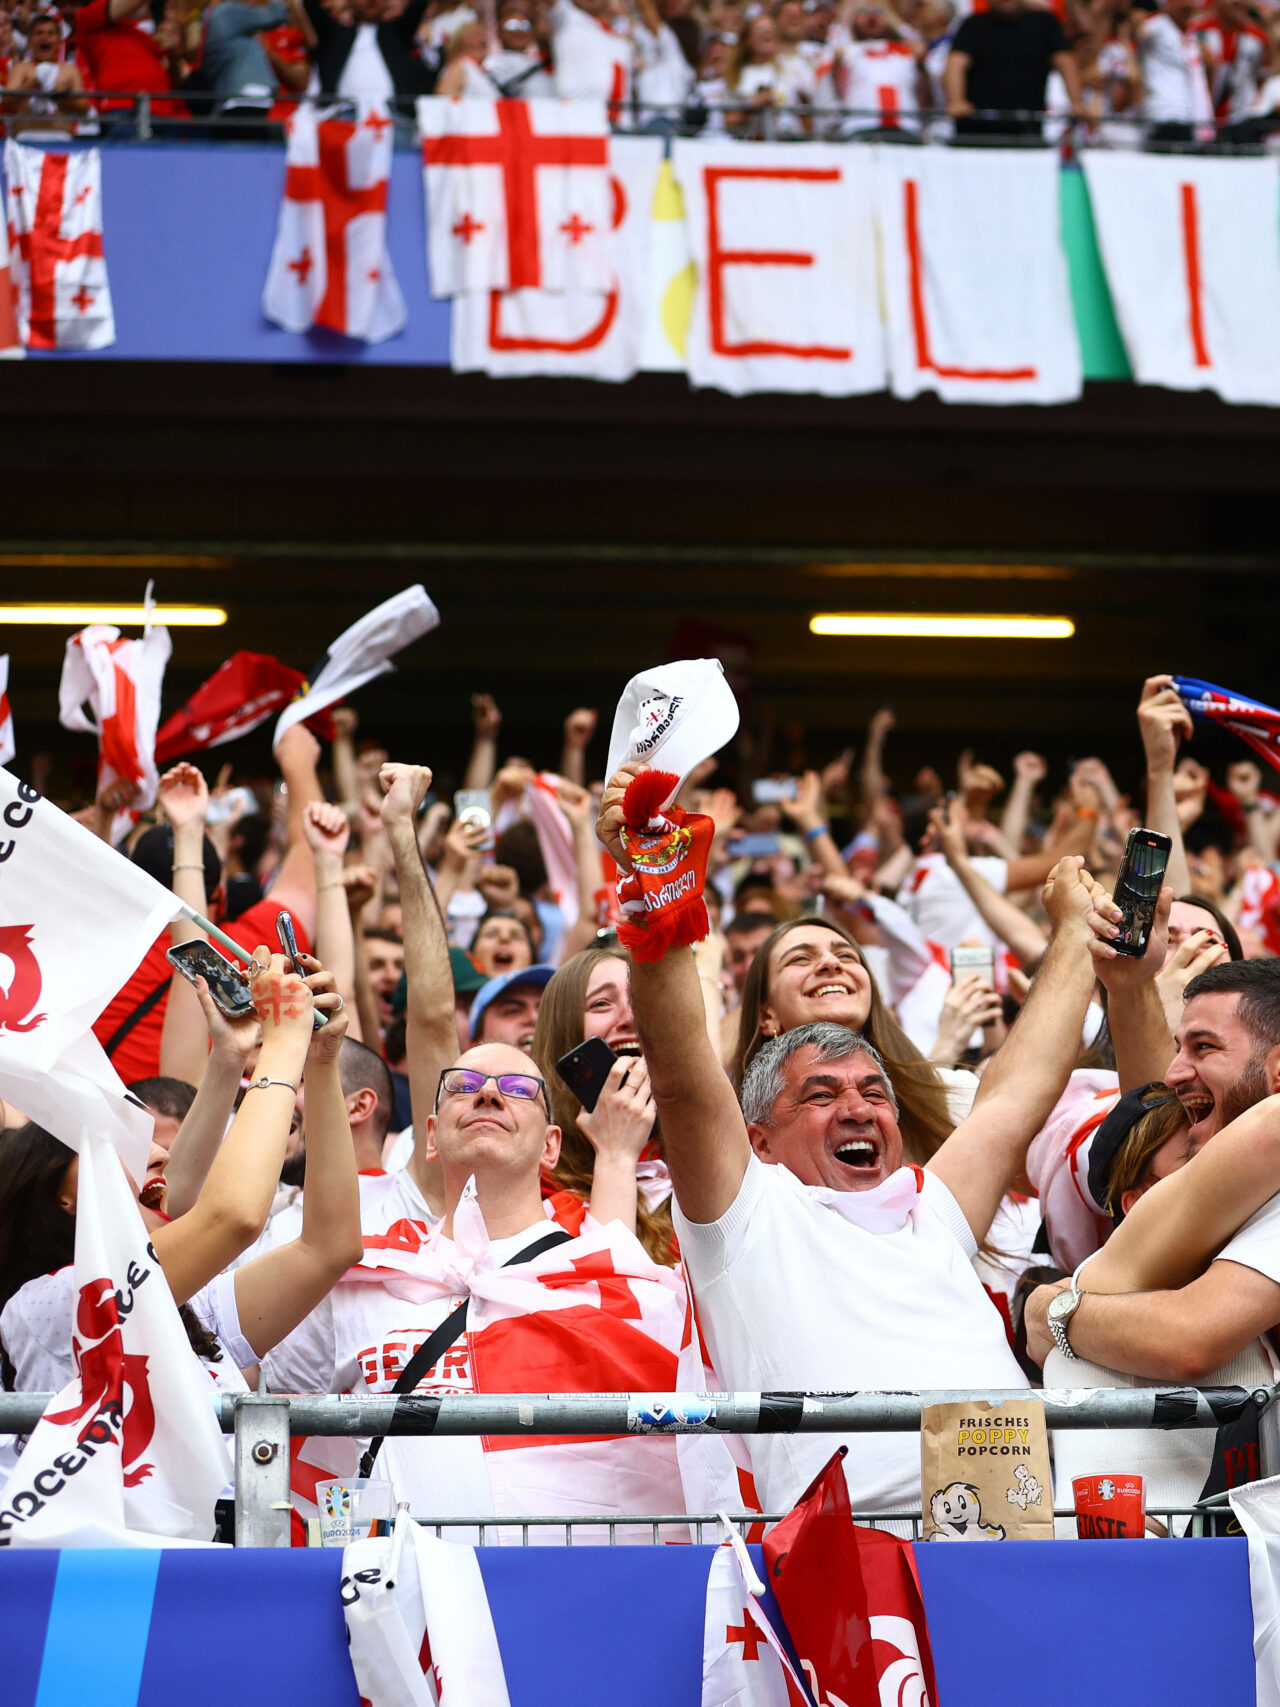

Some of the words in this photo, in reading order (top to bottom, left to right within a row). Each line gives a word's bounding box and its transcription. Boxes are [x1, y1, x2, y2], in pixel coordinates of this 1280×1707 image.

[959, 1417, 1029, 1428] FRISCHES
[957, 1428, 1030, 1445] POPPY
[957, 1445, 1031, 1456] POPCORN
